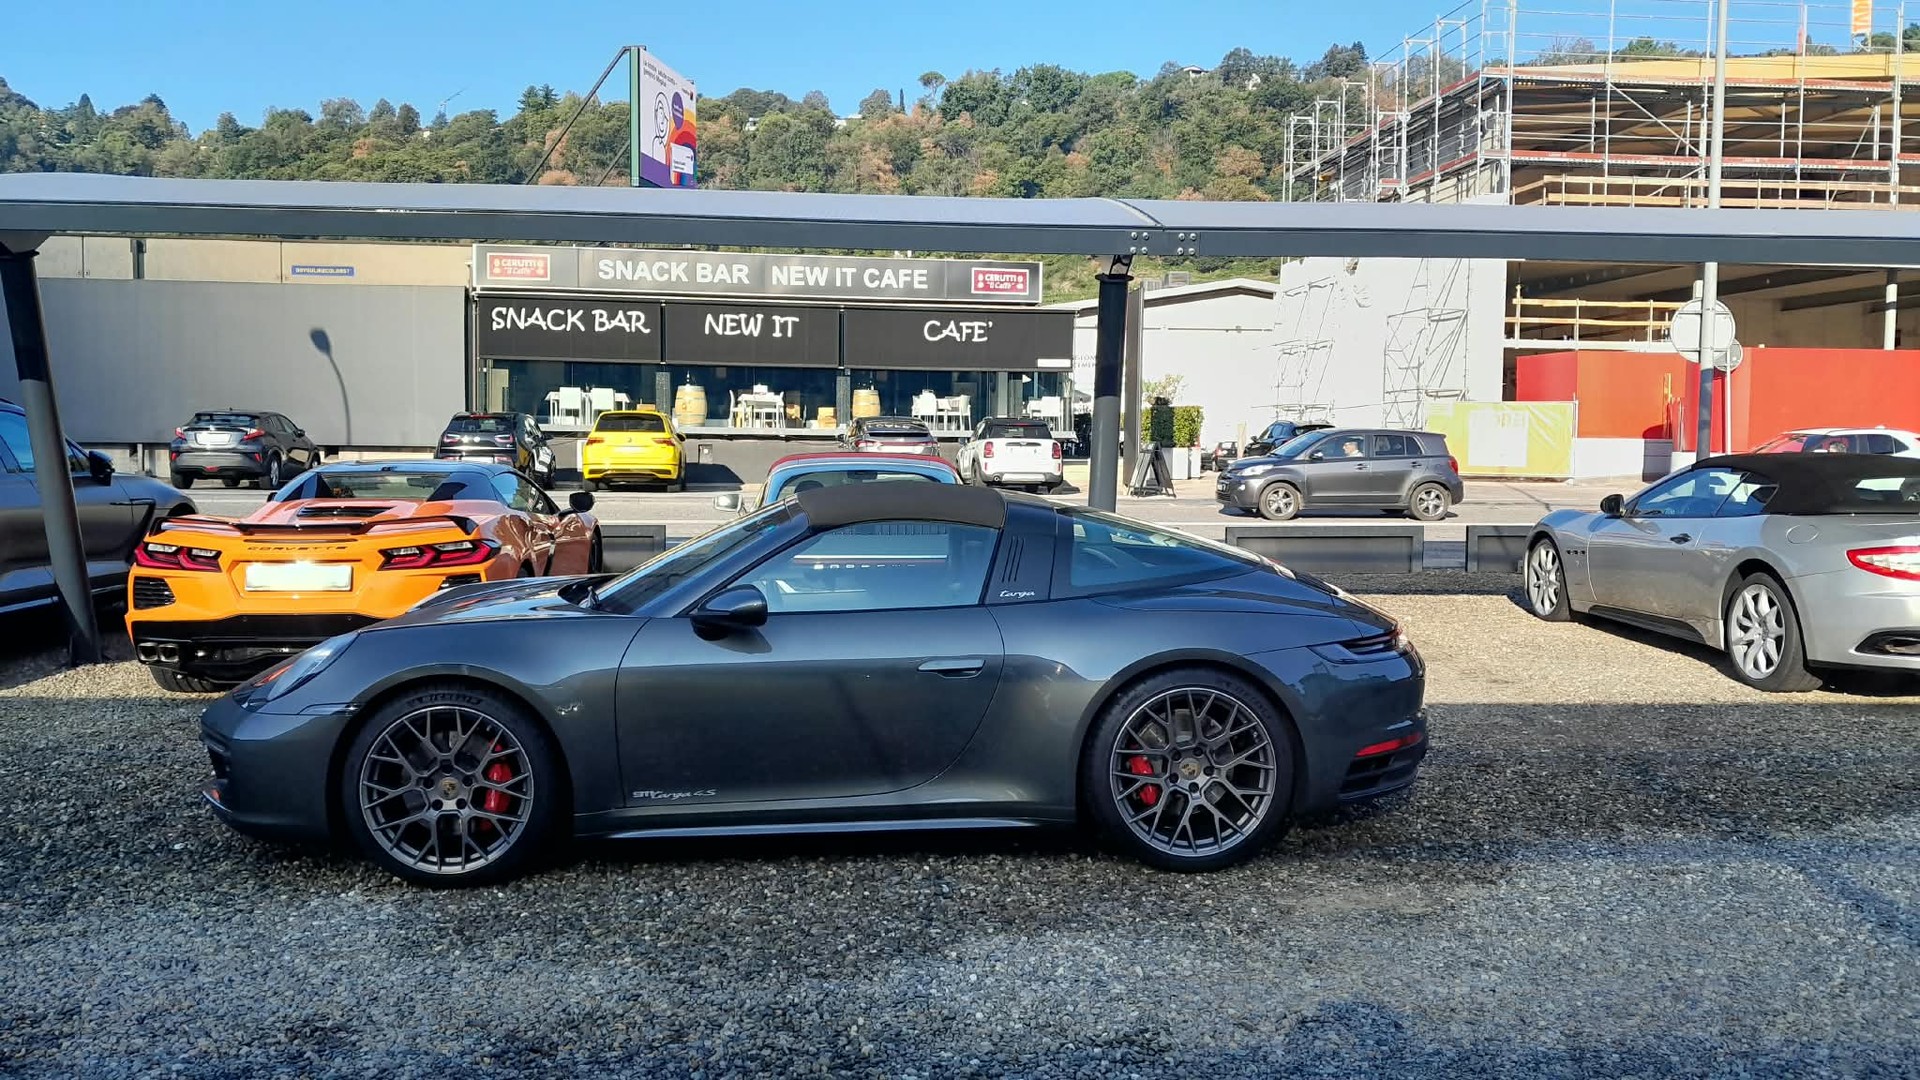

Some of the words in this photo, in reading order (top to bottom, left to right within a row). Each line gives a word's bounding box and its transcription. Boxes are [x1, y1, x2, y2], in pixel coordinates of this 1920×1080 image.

[501, 258, 537, 267] CERUTTI
[598, 259, 689, 283] SNACK
[696, 260, 750, 285] BAR
[771, 265, 829, 287] NEW
[835, 267, 856, 288] IT
[863, 267, 928, 289] CAFE
[985, 273, 1017, 283] CERUTTI
[491, 306, 585, 333] SNACK
[592, 310, 651, 334] BAR
[704, 313, 764, 337] NEW
[771, 315, 800, 338] IT
